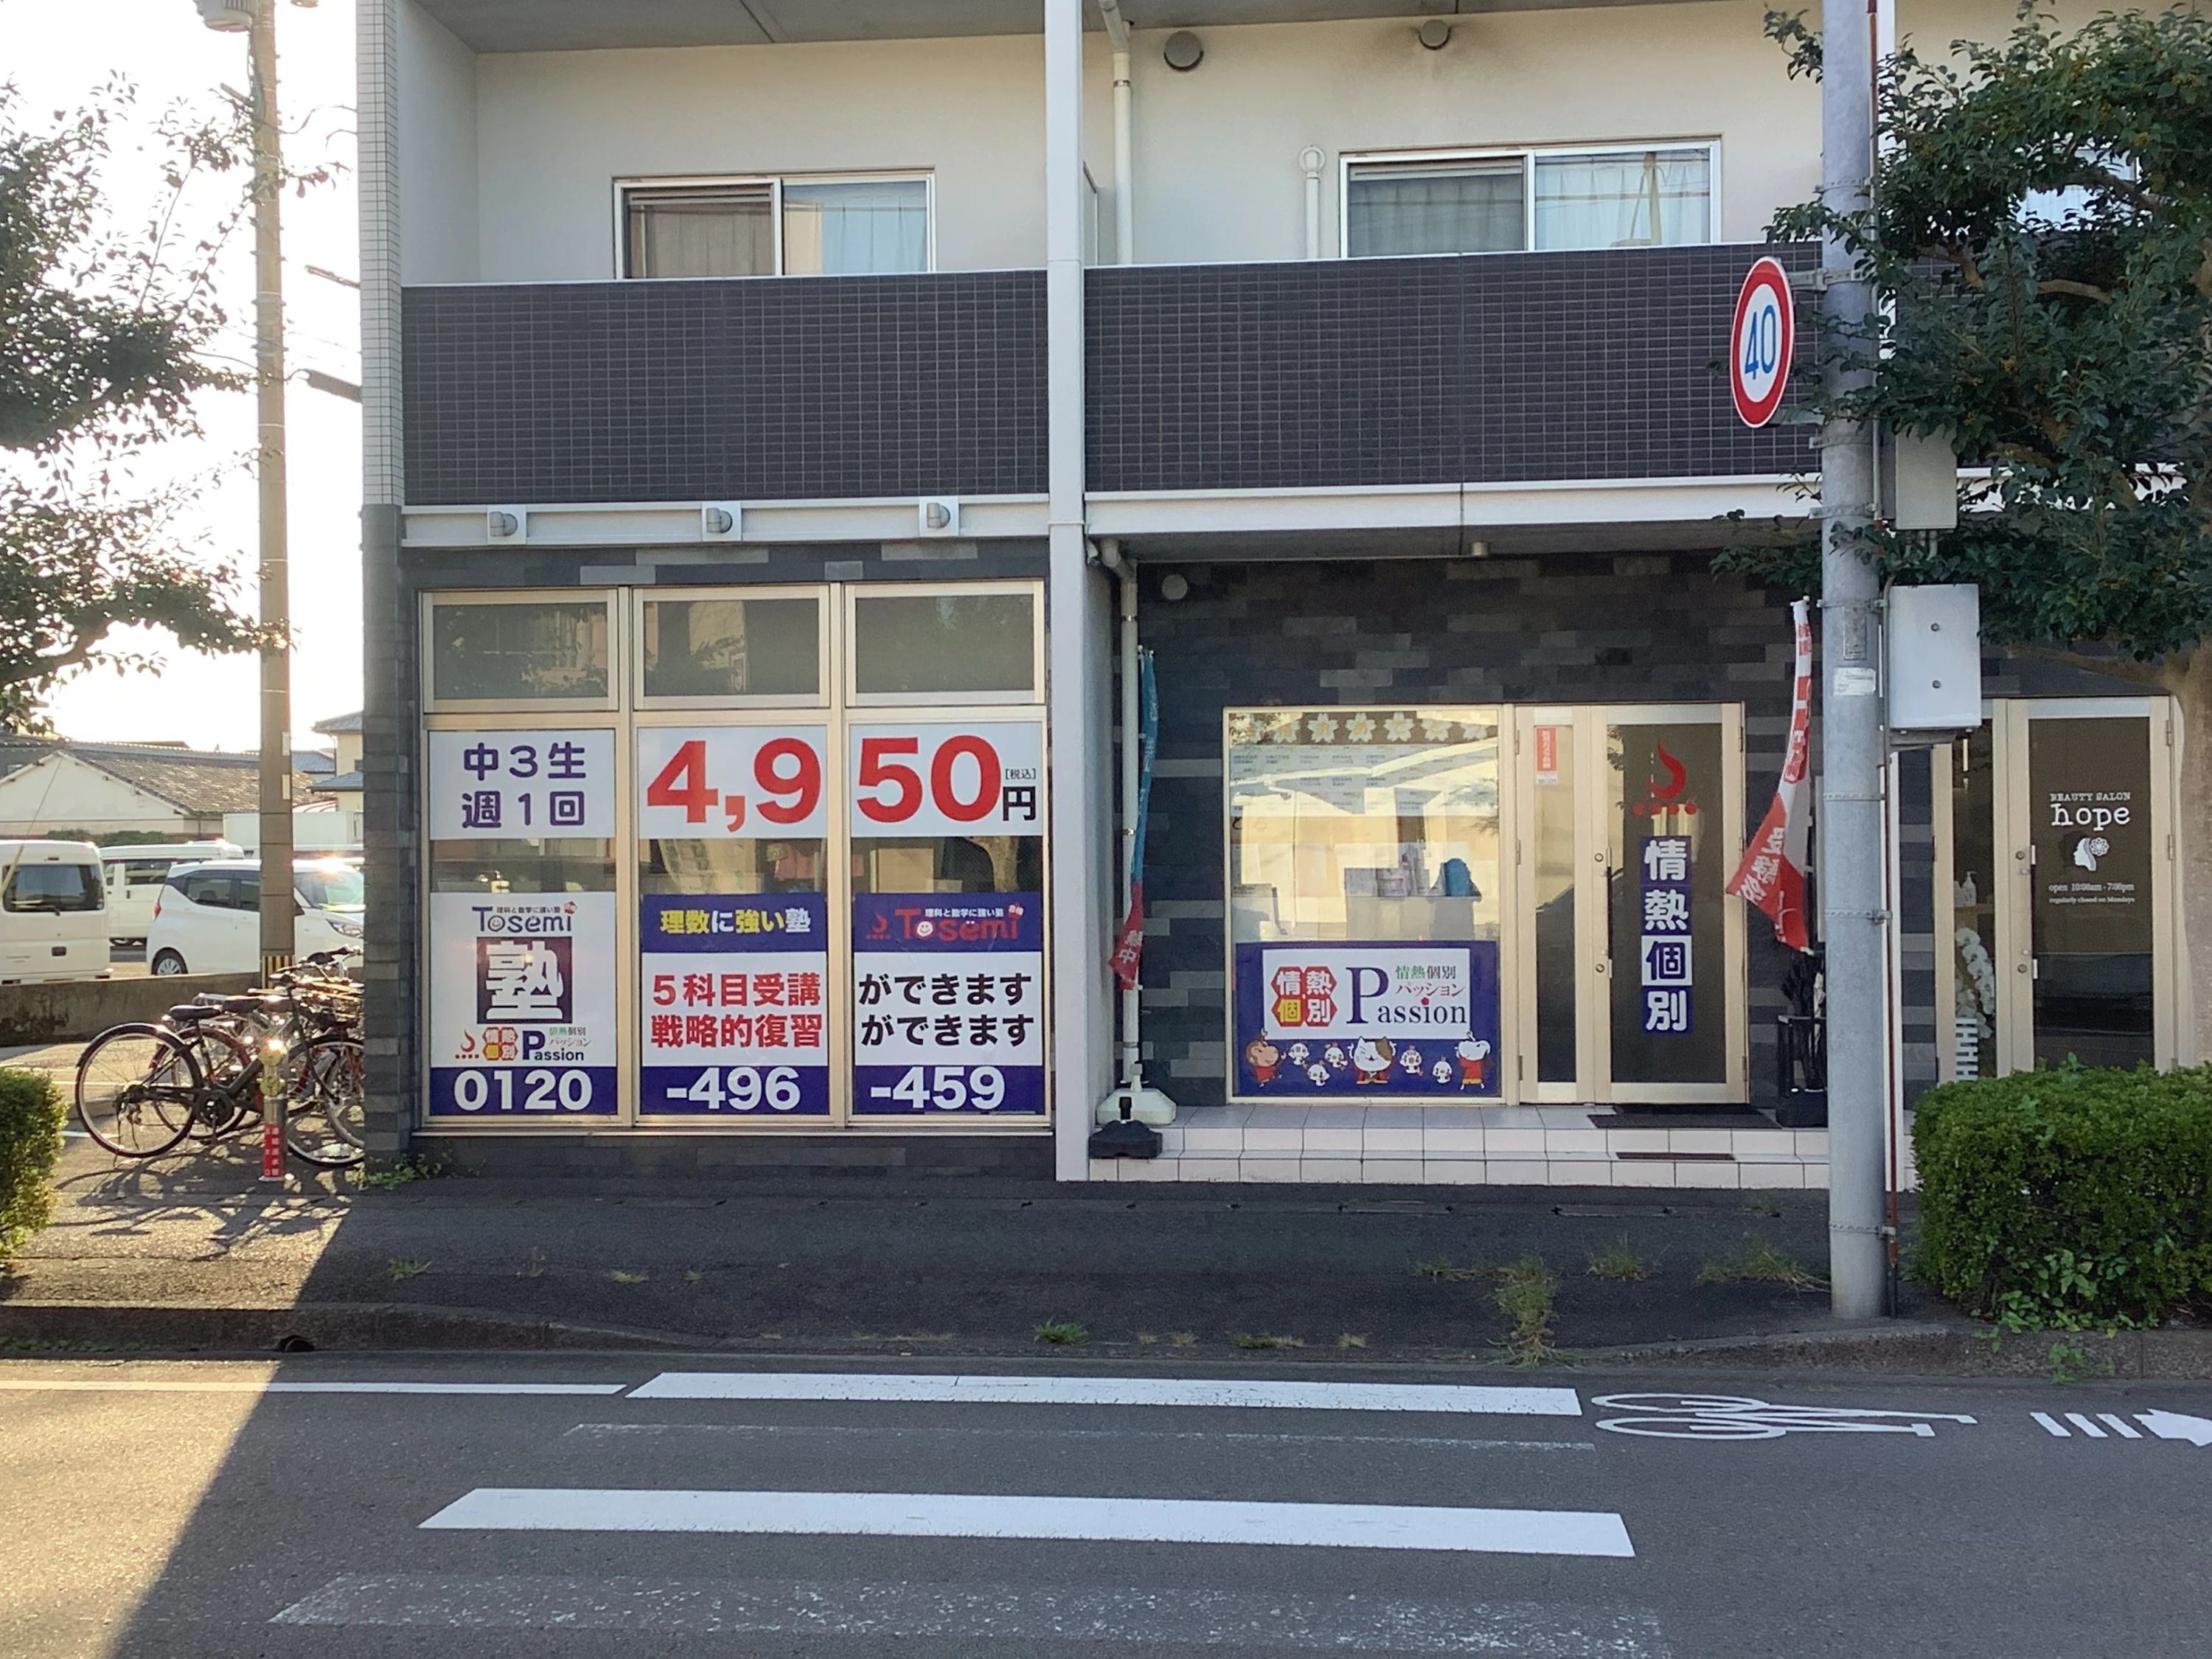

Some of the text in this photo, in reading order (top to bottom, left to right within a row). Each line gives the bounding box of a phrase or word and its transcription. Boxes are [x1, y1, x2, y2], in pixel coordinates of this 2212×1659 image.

[1745, 305, 1775, 380] 40
[464, 742, 586, 781] 中3生
[462, 791, 585, 828] 週1回
[2050, 792, 2131, 801] BEAUTY SALON
[2051, 803, 2130, 831] hope
[2048, 884, 2068, 894] open
[472, 906, 571, 933] Tosemi
[661, 908, 811, 933] 理数に強い塾
[894, 908, 1018, 942] Tosemi
[1644, 839, 1689, 1032] 情熱個別
[485, 940, 564, 1019] 塾
[1395, 965, 1456, 979] 情熱個別
[653, 973, 821, 1006] 5科目受講
[859, 973, 1032, 1006] ができます
[1346, 967, 1467, 1024] Passion
[1396, 982, 1466, 997] パッション
[523, 1031, 584, 1061] Passion
[651, 1014, 821, 1048] 戦略的復習
[861, 1014, 1034, 1047] ができます
[454, 1069, 592, 1110] 0120
